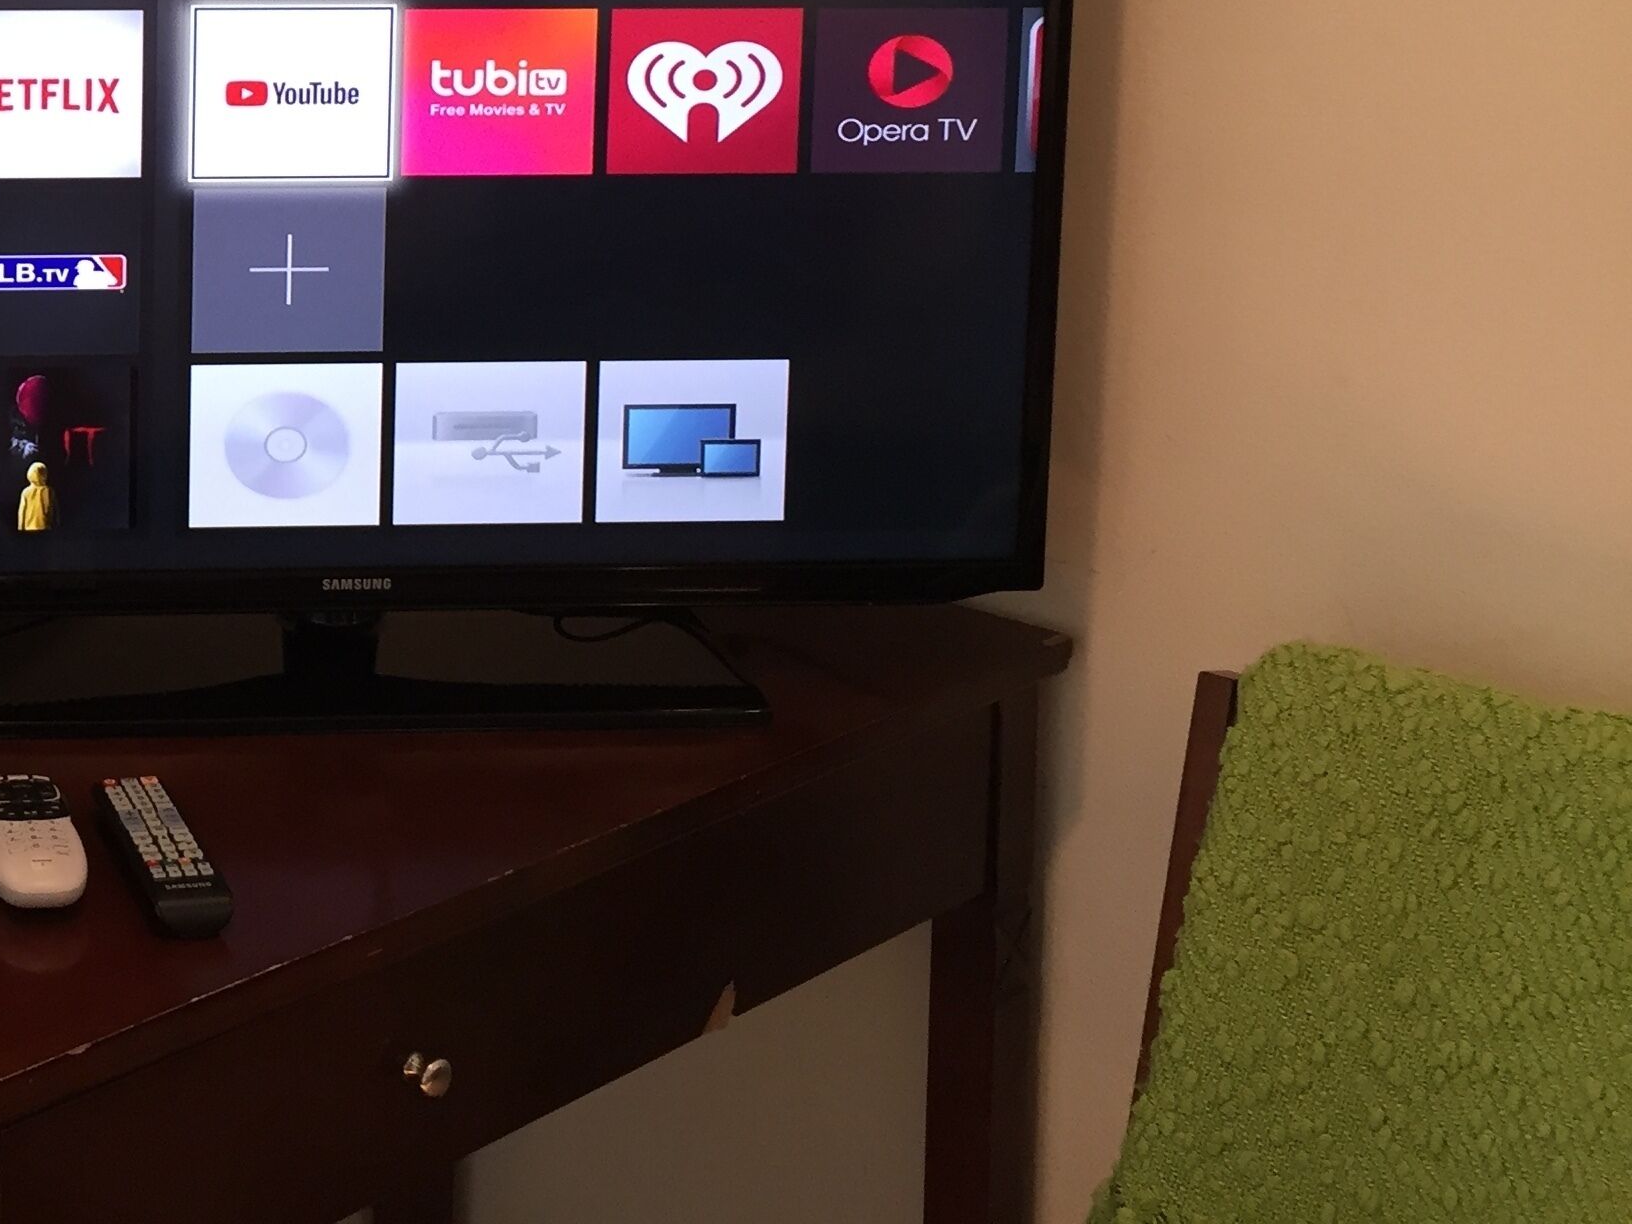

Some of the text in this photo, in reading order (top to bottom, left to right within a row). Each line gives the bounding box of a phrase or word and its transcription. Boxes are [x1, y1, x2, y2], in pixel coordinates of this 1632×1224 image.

[273, 82, 360, 107] YouTube
[430, 103, 566, 117] Free Movies & TV
[837, 118, 978, 146] Opera TV
[61, 426, 106, 467] IT
[321, 577, 392, 591] SAMSUNG
